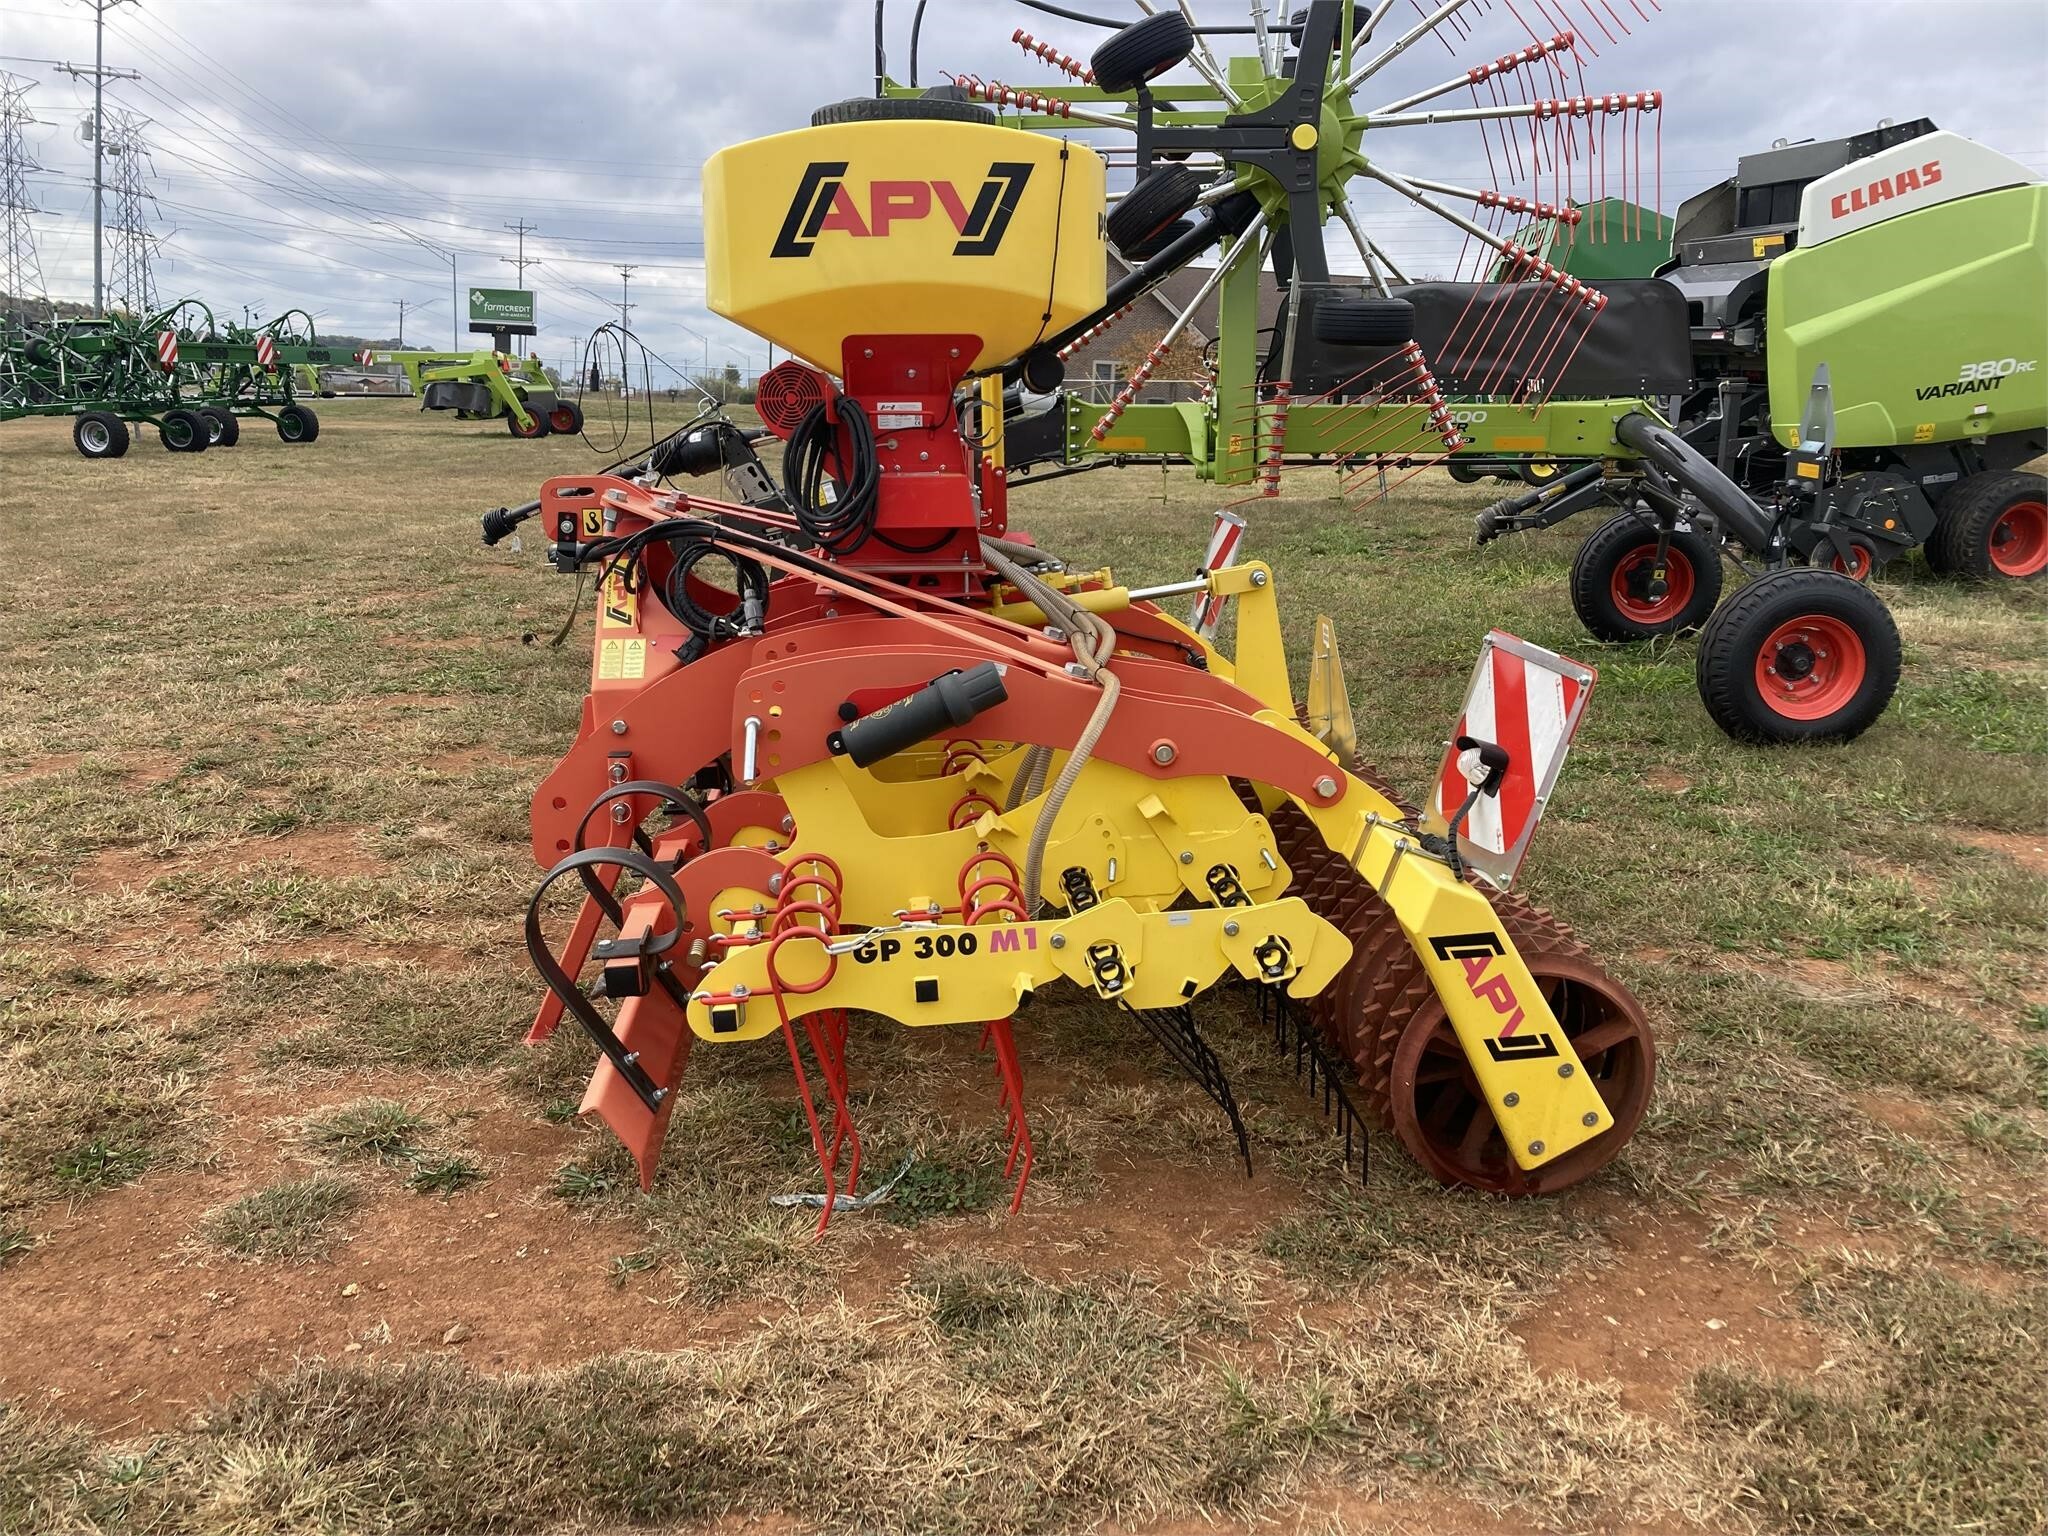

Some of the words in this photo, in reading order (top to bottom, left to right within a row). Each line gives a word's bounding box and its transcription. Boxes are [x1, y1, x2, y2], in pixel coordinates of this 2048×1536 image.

[800, 180, 1004, 237] APV
[1831, 160, 1942, 219] CLAAS
[1915, 376, 2006, 401] VARIANT
[853, 939, 901, 965] GP
[914, 932, 978, 960] 300
[989, 927, 1038, 954] M1
[1450, 948, 1541, 1049] APV
